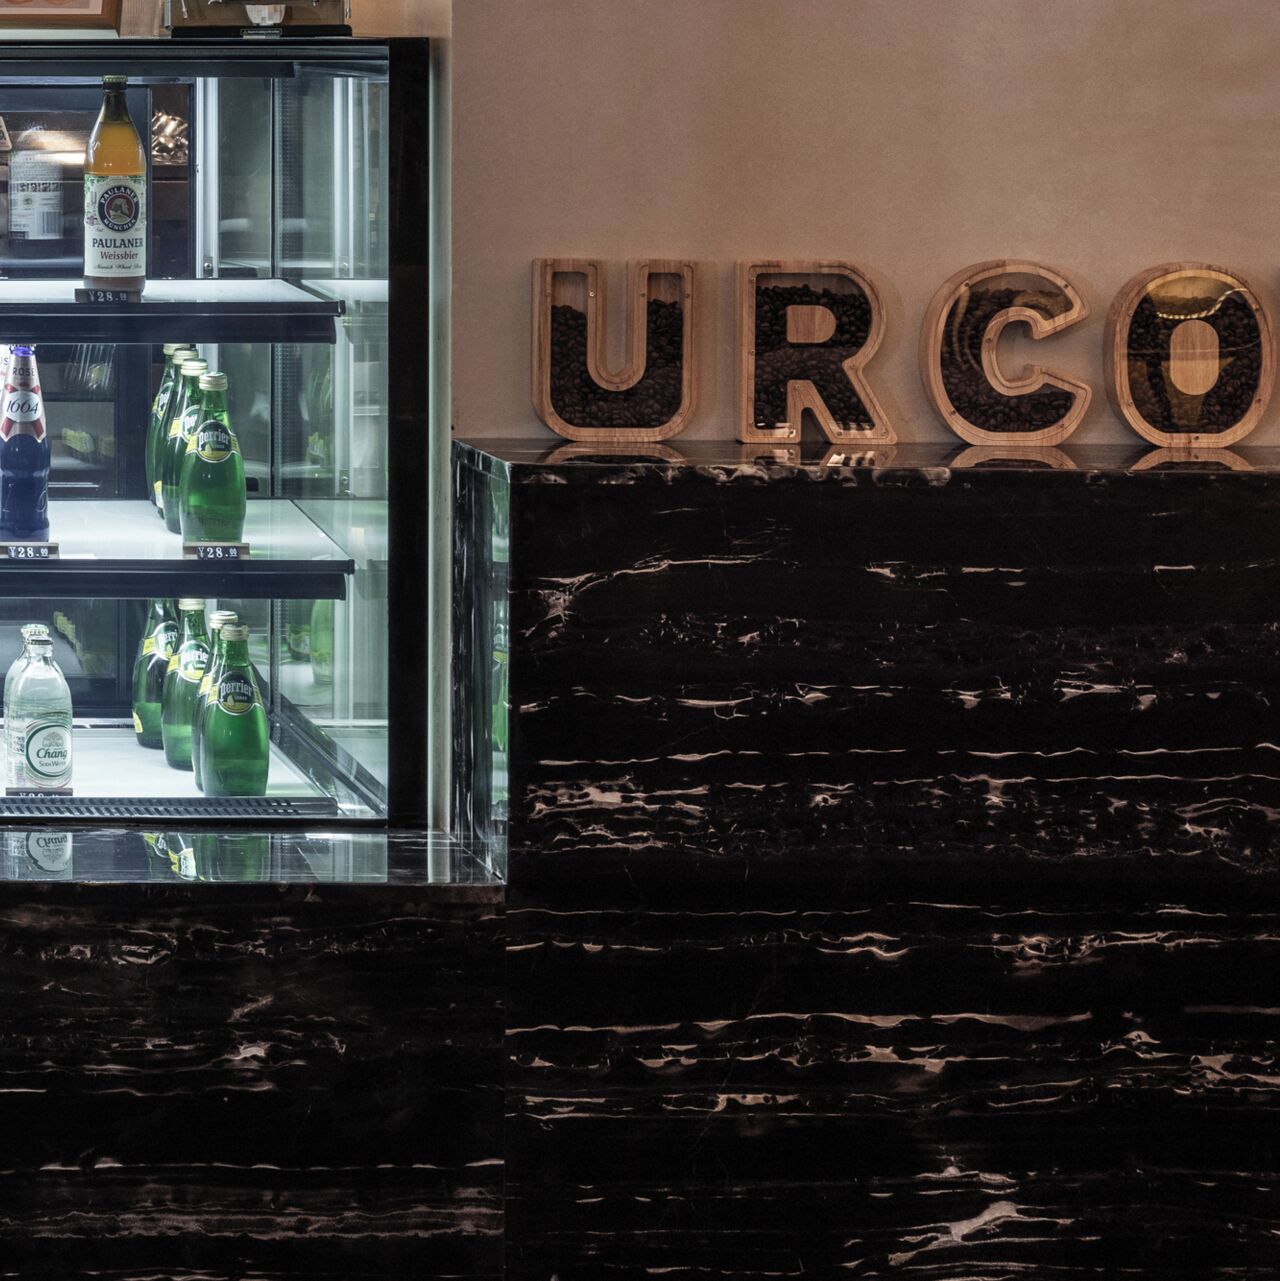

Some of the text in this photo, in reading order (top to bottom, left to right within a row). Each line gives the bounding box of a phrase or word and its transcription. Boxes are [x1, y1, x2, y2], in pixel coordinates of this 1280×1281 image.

[100, 186, 139, 204] PAULANER
[92, 238, 144, 248] PAULANER
[100, 250, 139, 260] Weissbier
[6, 398, 39, 414] 1664
[36, 748, 68, 760] Chang
